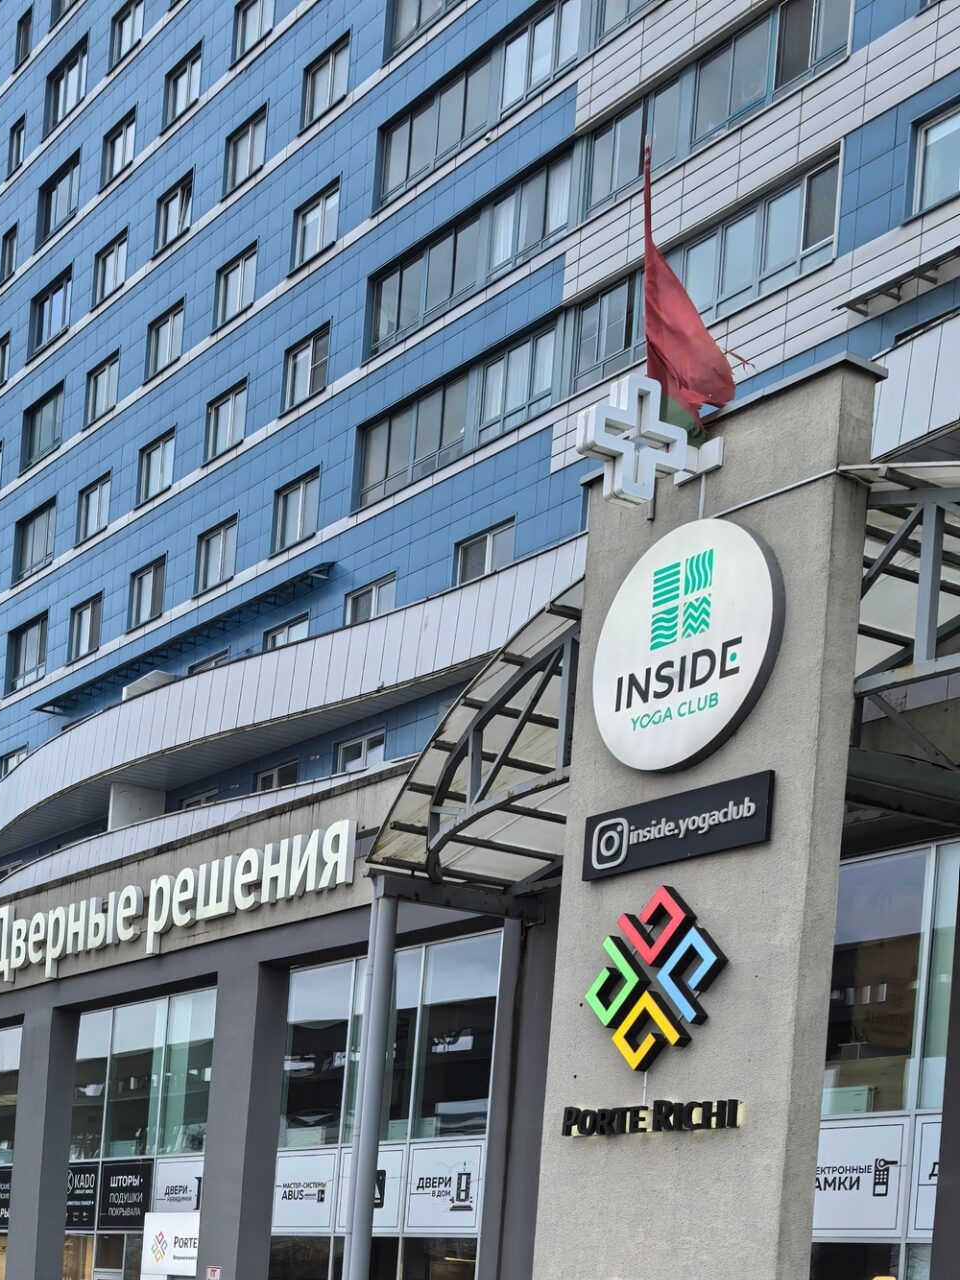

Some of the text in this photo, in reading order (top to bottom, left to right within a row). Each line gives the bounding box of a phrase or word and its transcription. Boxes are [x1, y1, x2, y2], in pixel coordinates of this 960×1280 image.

[614, 636, 743, 712] INSIDE
[631, 692, 719, 732] YOGA CLUB
[629, 797, 756, 845] inside.yogaclub
[146, 819, 357, 955] решения
[561, 1099, 739, 1136] PORTE RICHI
[816, 1164, 873, 1175] ЕКТРОННЫЕ
[74, 1173, 96, 1188] KADO
[110, 1175, 140, 1188] ШТОРЫ
[416, 1176, 452, 1191] ДВЕРИ
[815, 1176, 861, 1191] АМКИ
[108, 1192, 143, 1205] ПОДУШКИ
[281, 1189, 304, 1201] ABUS
[173, 1236, 198, 1248] PORTE
